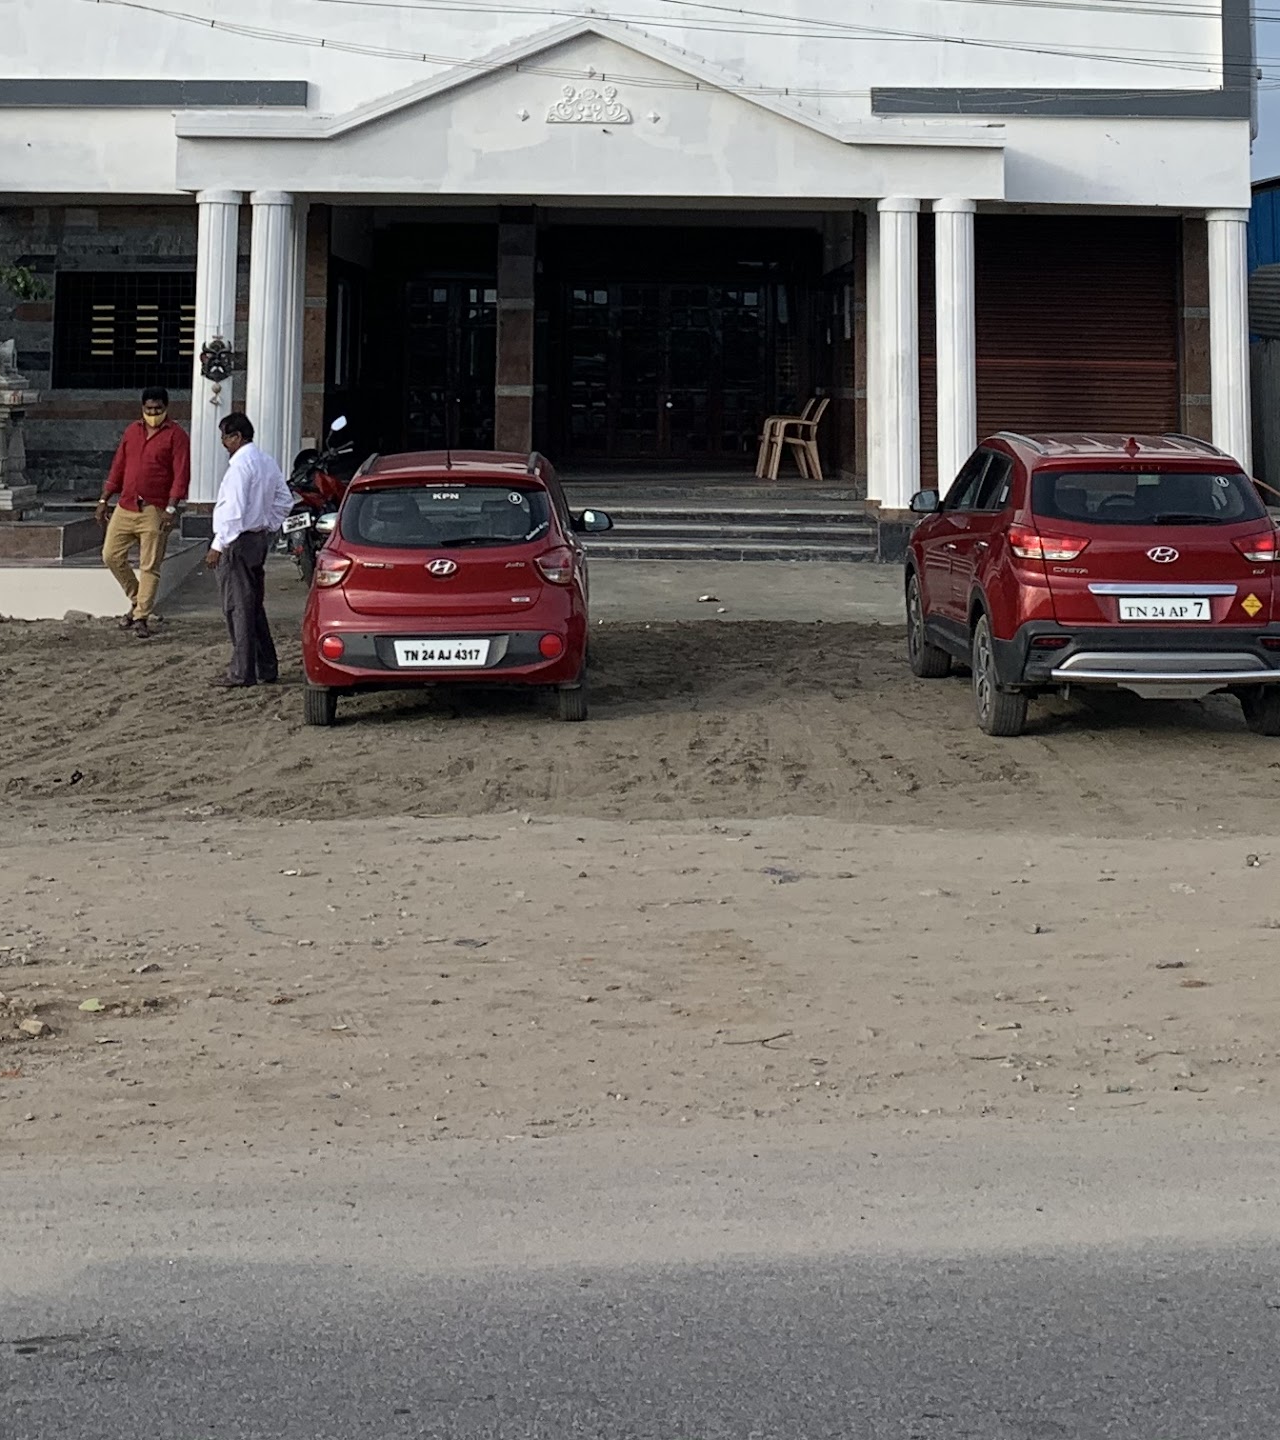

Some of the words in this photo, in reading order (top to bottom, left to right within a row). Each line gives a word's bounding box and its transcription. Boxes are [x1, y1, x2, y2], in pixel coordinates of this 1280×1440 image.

[1124, 606, 1148, 617] TN
[1151, 606, 1165, 617] 24
[1168, 606, 1189, 617] AP
[1193, 602, 1204, 617] 7
[404, 649, 419, 661] TN
[422, 649, 435, 661] 24
[437, 649, 452, 661] AJ
[455, 649, 481, 660] 4317
